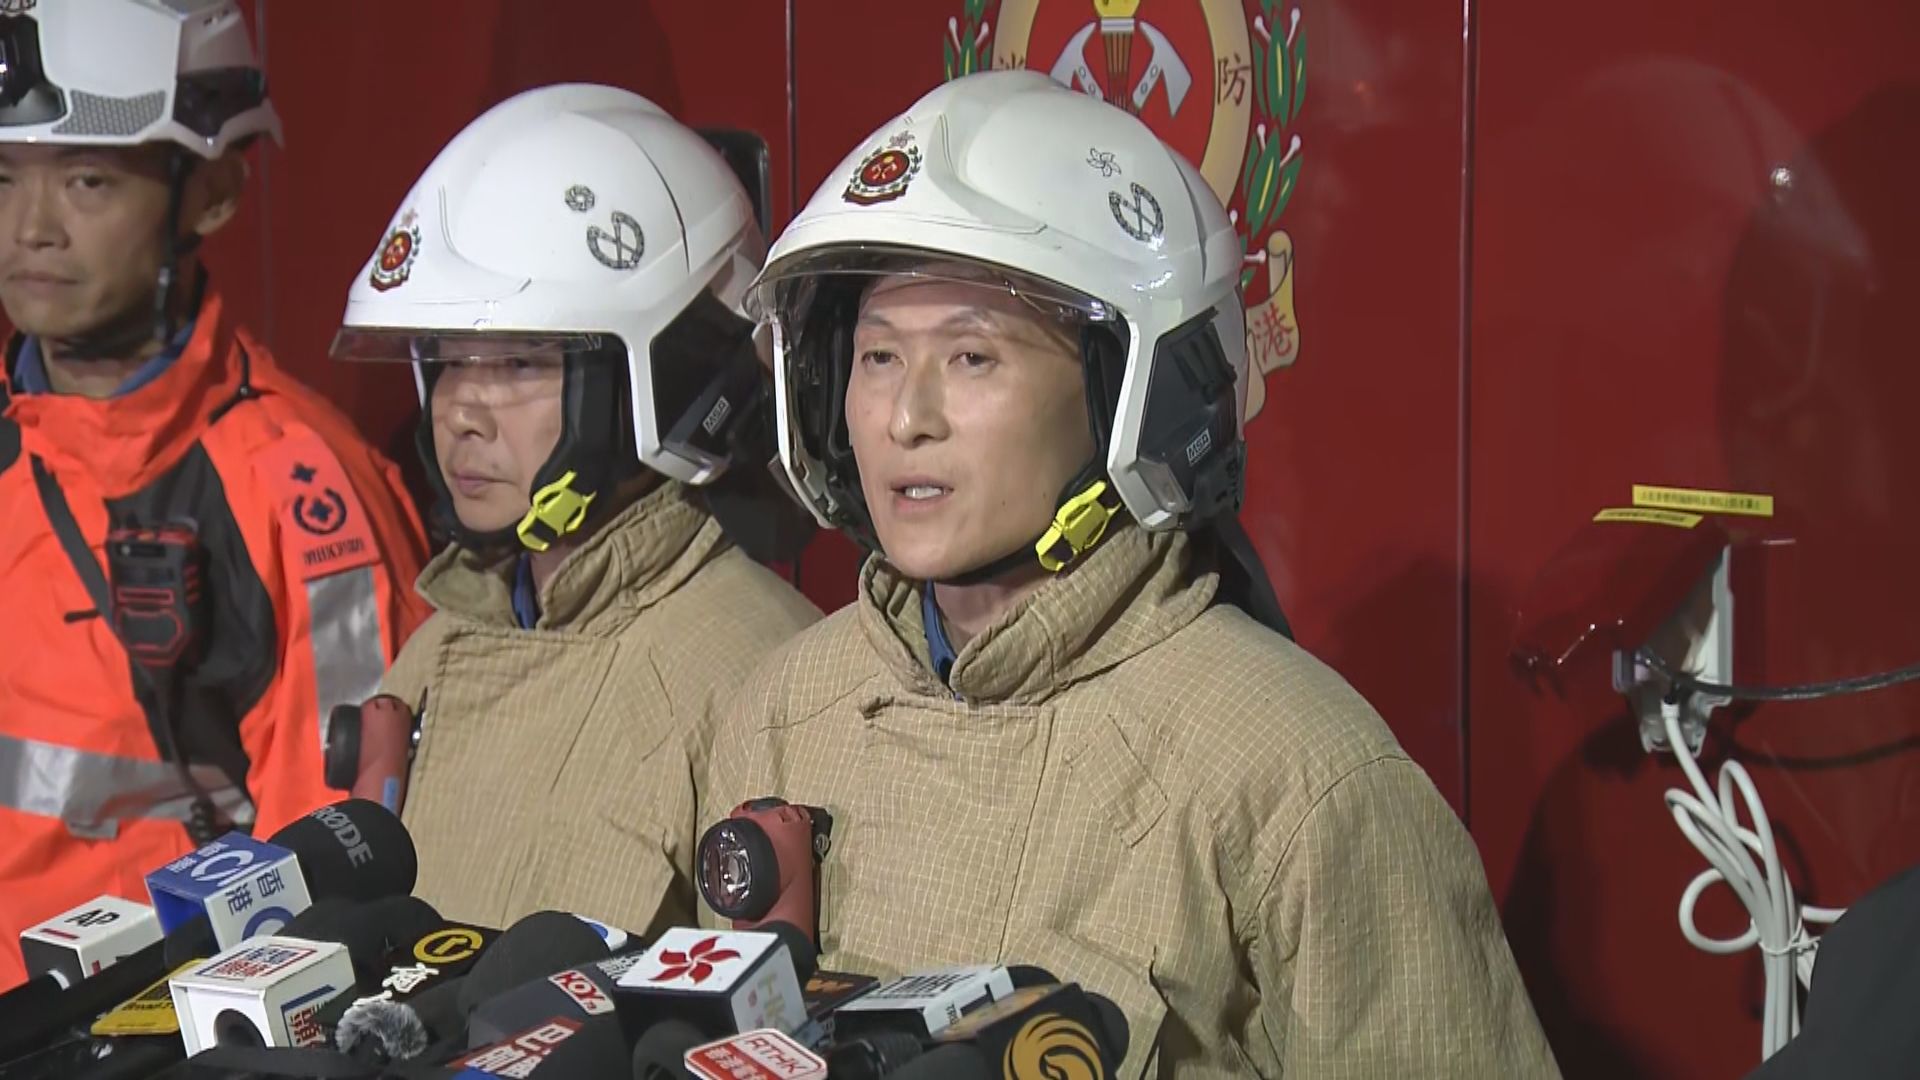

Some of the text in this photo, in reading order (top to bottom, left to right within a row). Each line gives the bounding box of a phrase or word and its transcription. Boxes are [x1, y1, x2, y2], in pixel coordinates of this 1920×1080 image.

[1217, 53, 1251, 107] 防
[1253, 302, 1294, 362] 港
[64, 909, 120, 928] AP
[744, 1038, 808, 1074] RTHK
